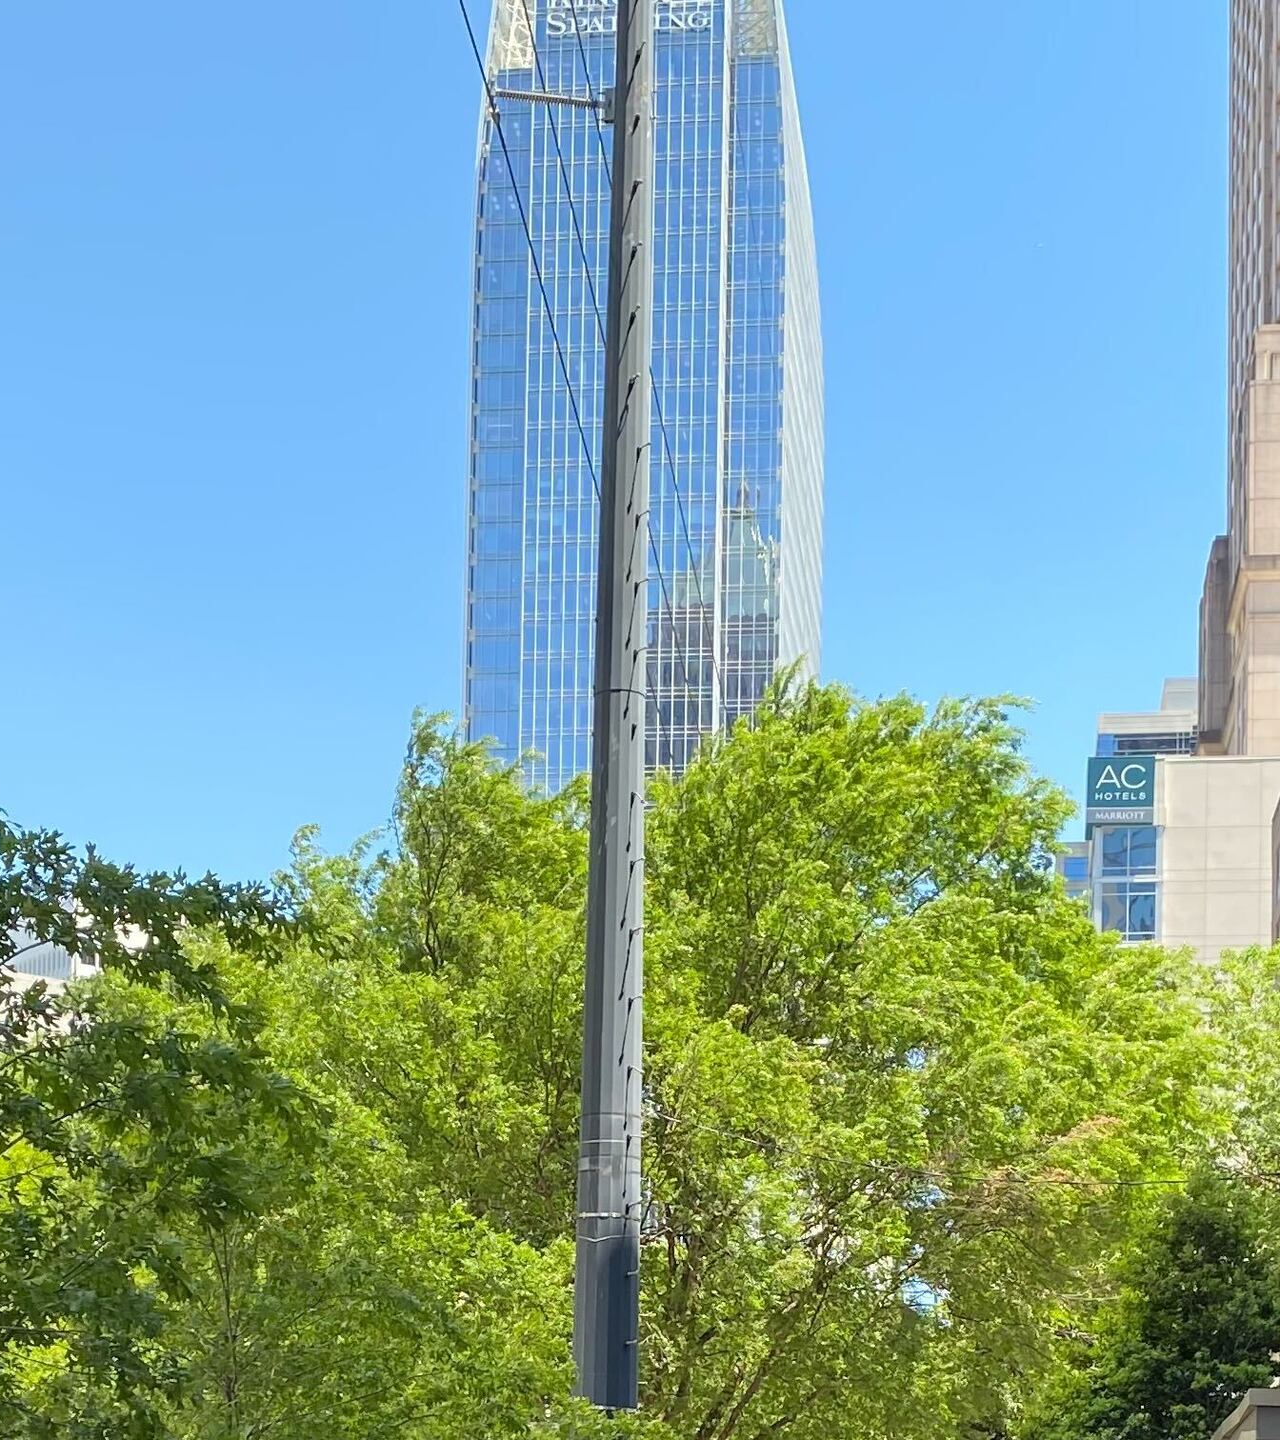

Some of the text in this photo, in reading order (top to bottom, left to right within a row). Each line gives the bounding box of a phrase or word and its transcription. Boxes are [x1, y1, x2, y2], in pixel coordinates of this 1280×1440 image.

[1095, 764, 1147, 789] AC
[1094, 791, 1147, 801] HOTELS
[1095, 811, 1146, 821] MARRIOTT
